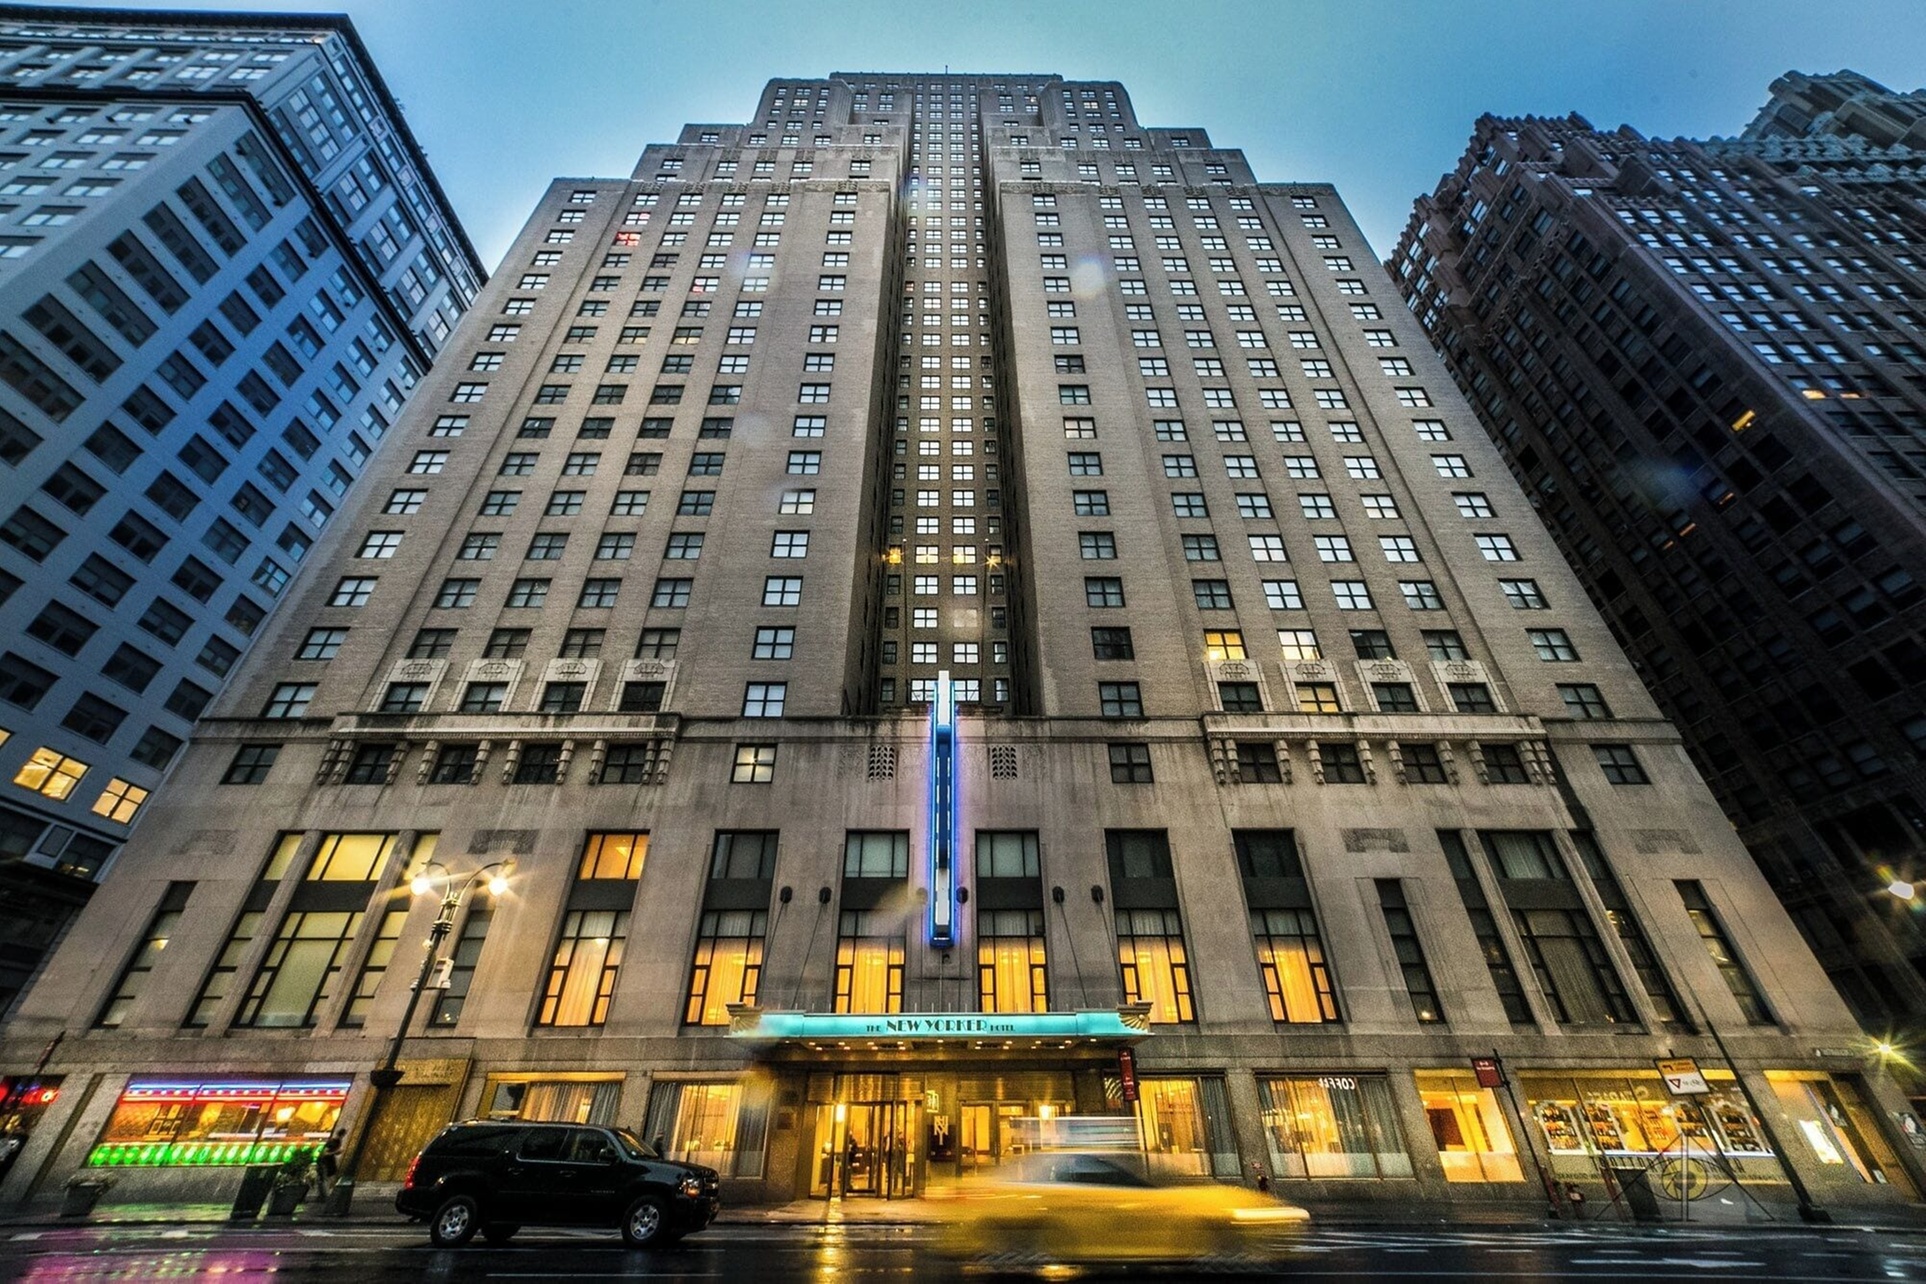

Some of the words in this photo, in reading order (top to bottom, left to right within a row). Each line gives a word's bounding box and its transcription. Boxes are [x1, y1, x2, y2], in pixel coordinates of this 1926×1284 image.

[886, 1019, 922, 1032] NEW
[924, 1019, 988, 1032] YORKER
[990, 1024, 1016, 1032] HOTEL
